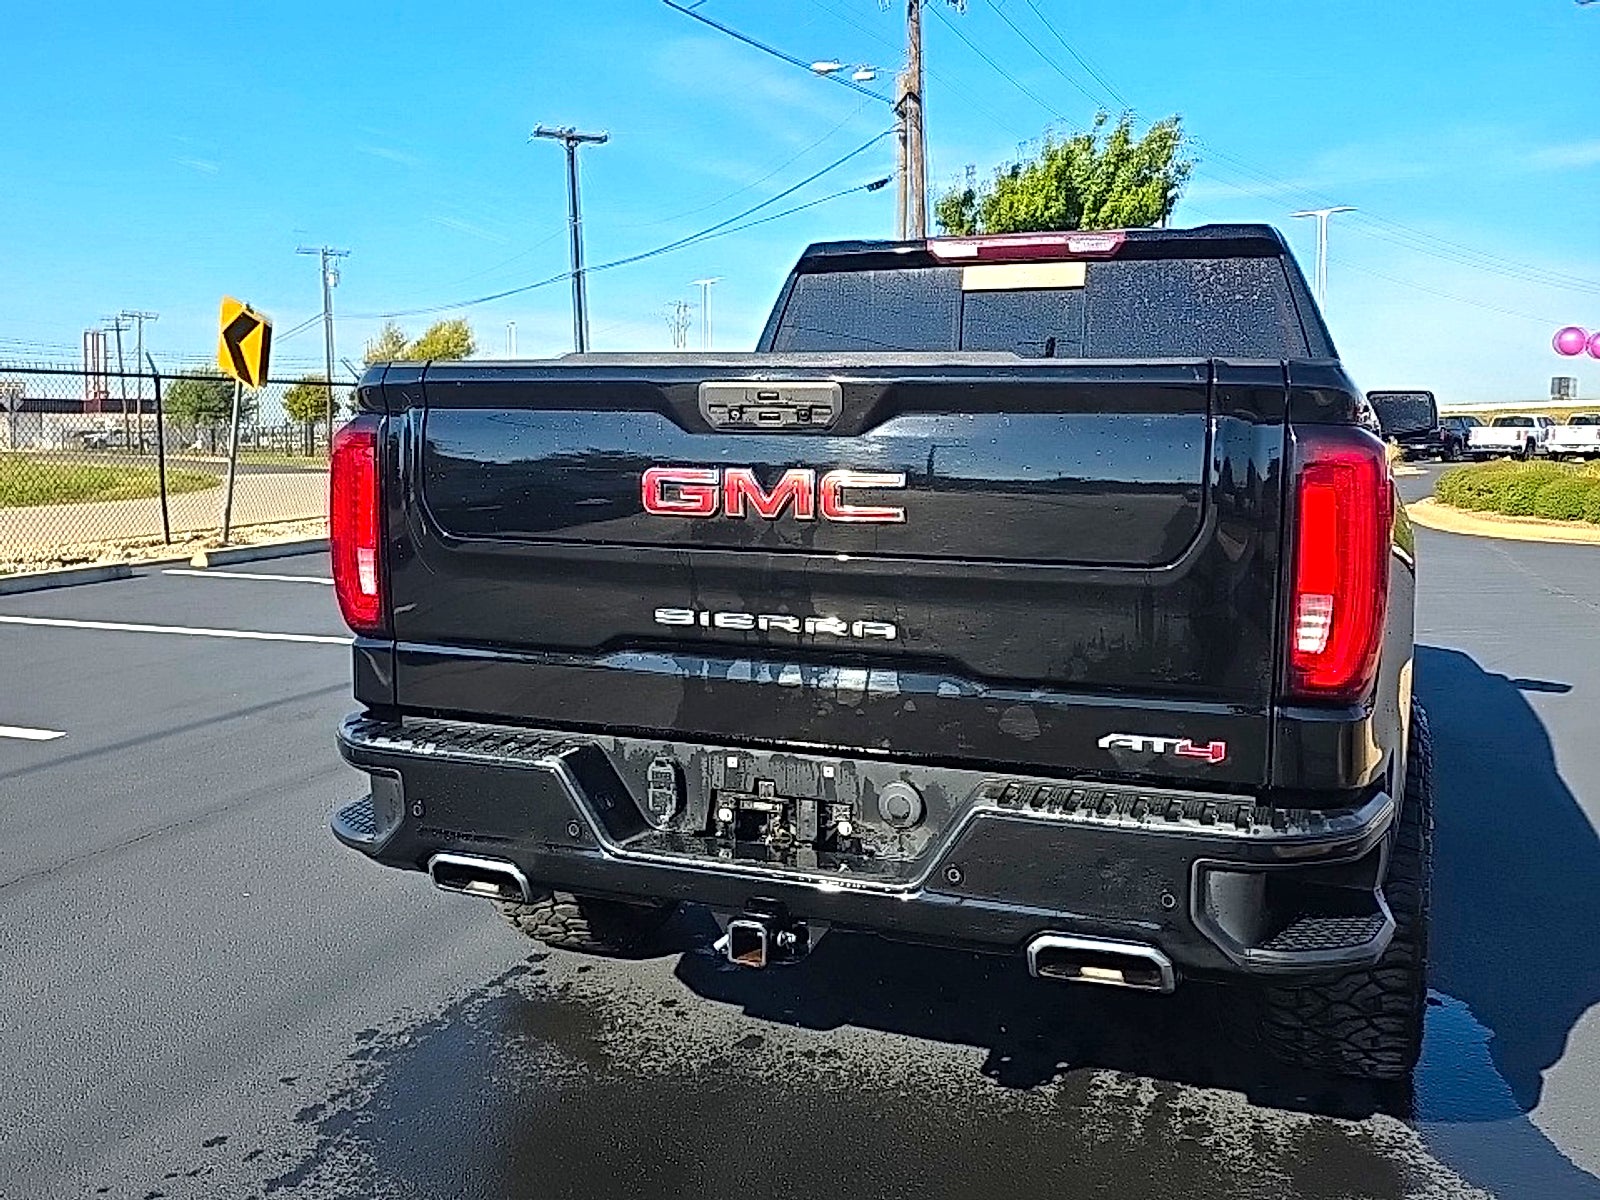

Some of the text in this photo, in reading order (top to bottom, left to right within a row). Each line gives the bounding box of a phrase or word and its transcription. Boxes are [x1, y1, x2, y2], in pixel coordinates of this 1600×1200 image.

[641, 467, 906, 523] GMC
[654, 608, 897, 640] SIERRA
[1098, 733, 1226, 763] AT4
